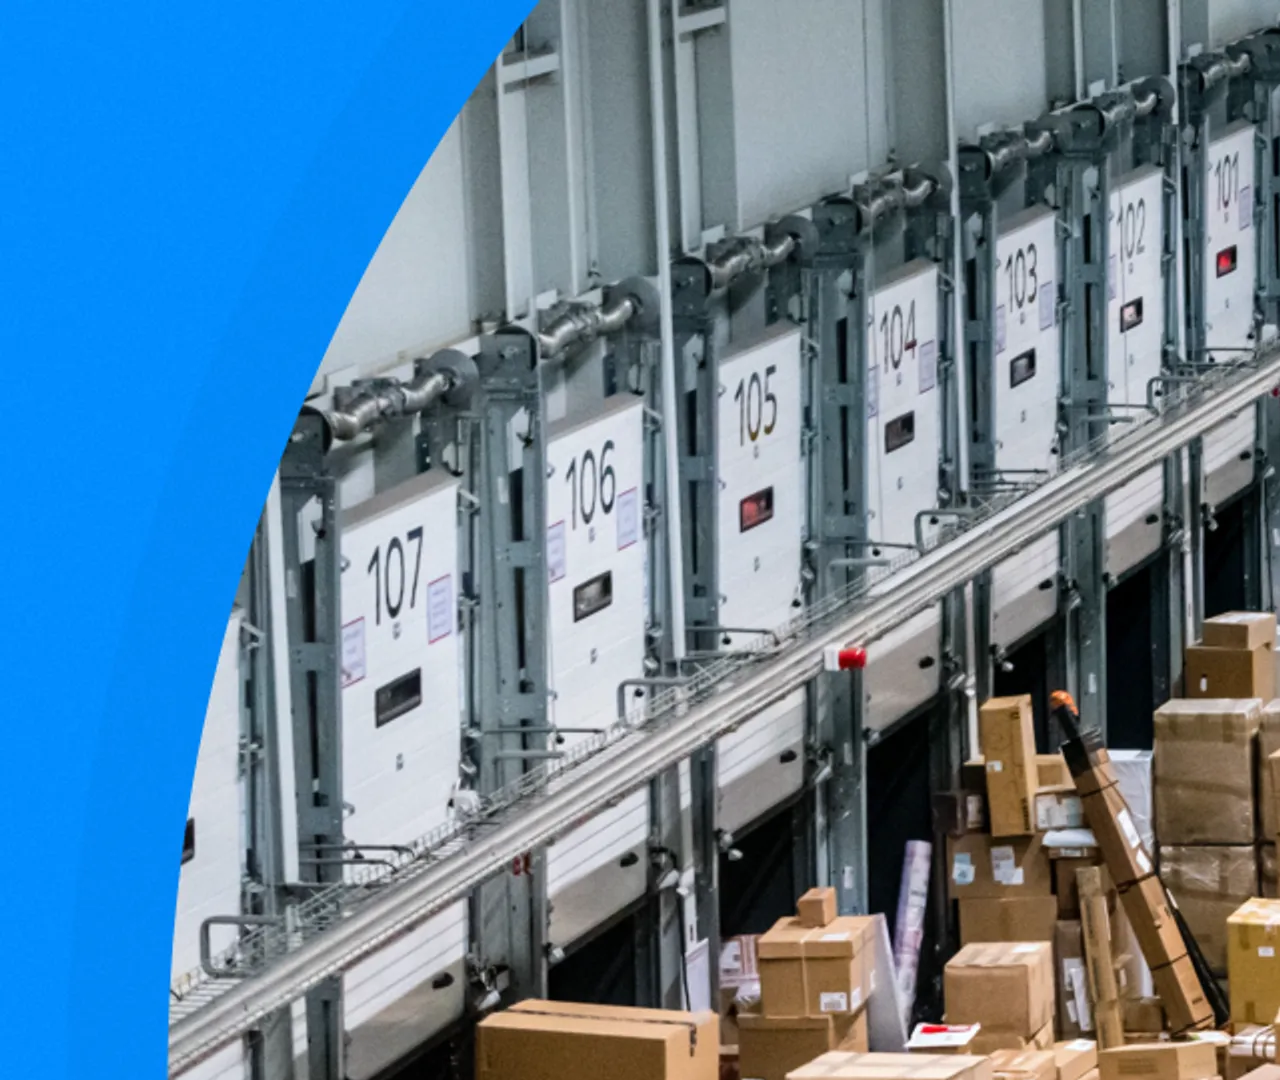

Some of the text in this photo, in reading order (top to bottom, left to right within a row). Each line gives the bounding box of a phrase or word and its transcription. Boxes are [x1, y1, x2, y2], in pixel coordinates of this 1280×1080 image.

[1214, 151, 1240, 213] 101
[1116, 198, 1147, 264] 102
[1004, 243, 1039, 313] 103
[879, 299, 918, 374] 104
[734, 364, 778, 448] 105
[565, 439, 618, 531] 106
[367, 525, 425, 627] 107
